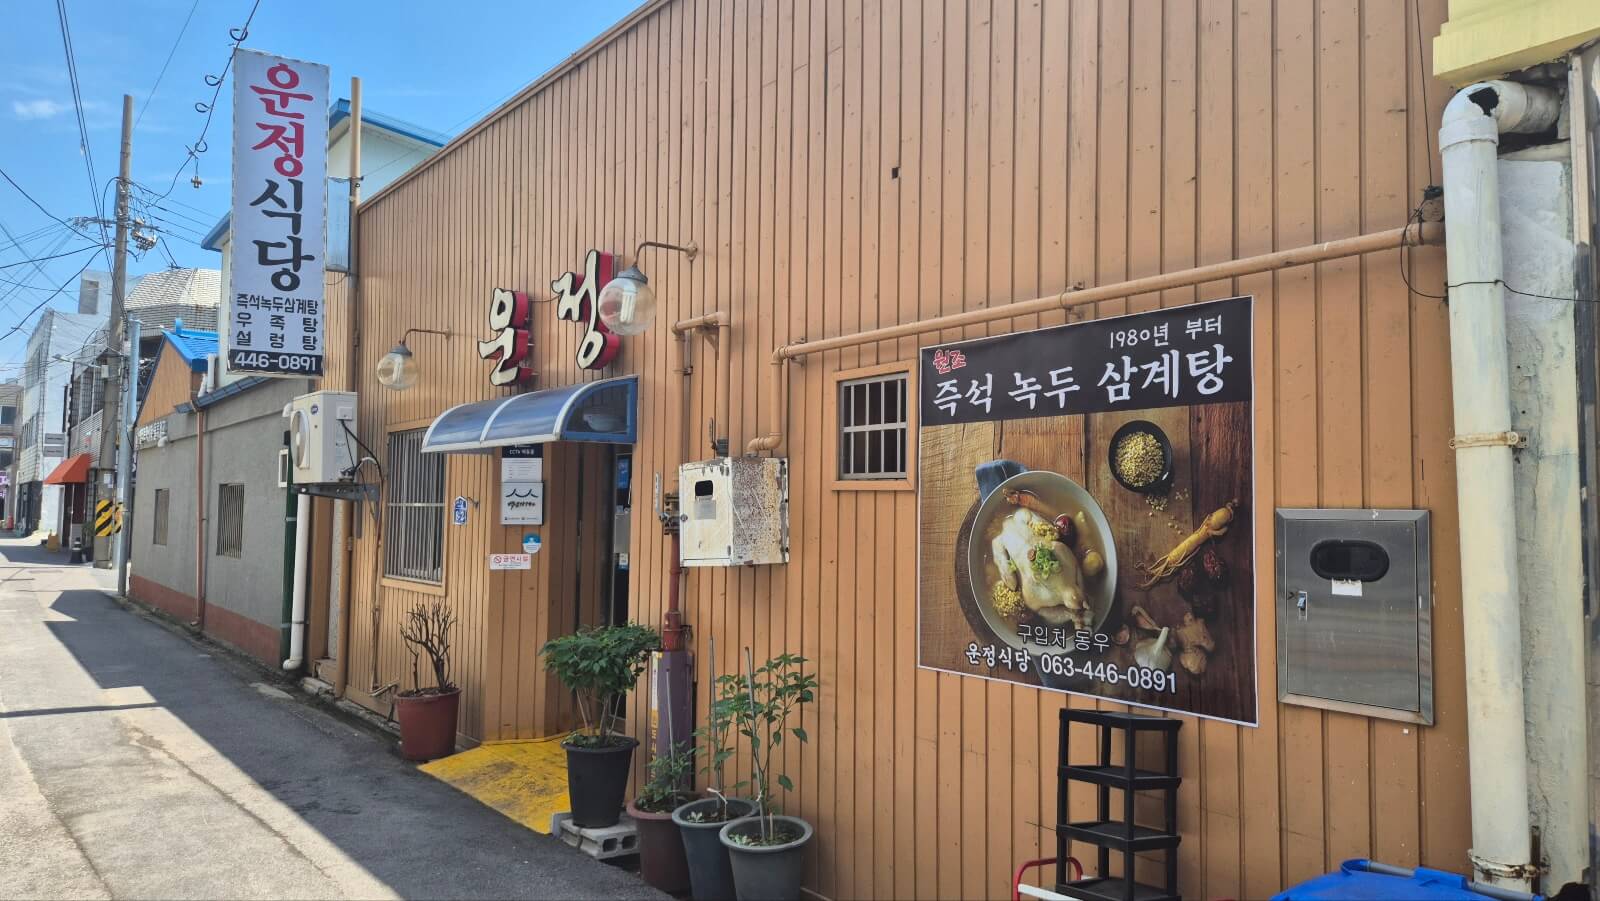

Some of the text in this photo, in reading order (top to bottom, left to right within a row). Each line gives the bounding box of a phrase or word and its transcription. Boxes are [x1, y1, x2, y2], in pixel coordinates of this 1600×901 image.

[236, 293, 318, 315] 즉석녹두삼계탕
[1109, 315, 1222, 349] 1980년 부터
[234, 352, 316, 371] 446-0891
[932, 349, 967, 374] 원조
[932, 343, 1233, 416] 즉석 녹두 삼계탕
[1017, 624, 1111, 654] 구입처 동우
[965, 643, 1178, 694] 운정식당 063-446-0891
